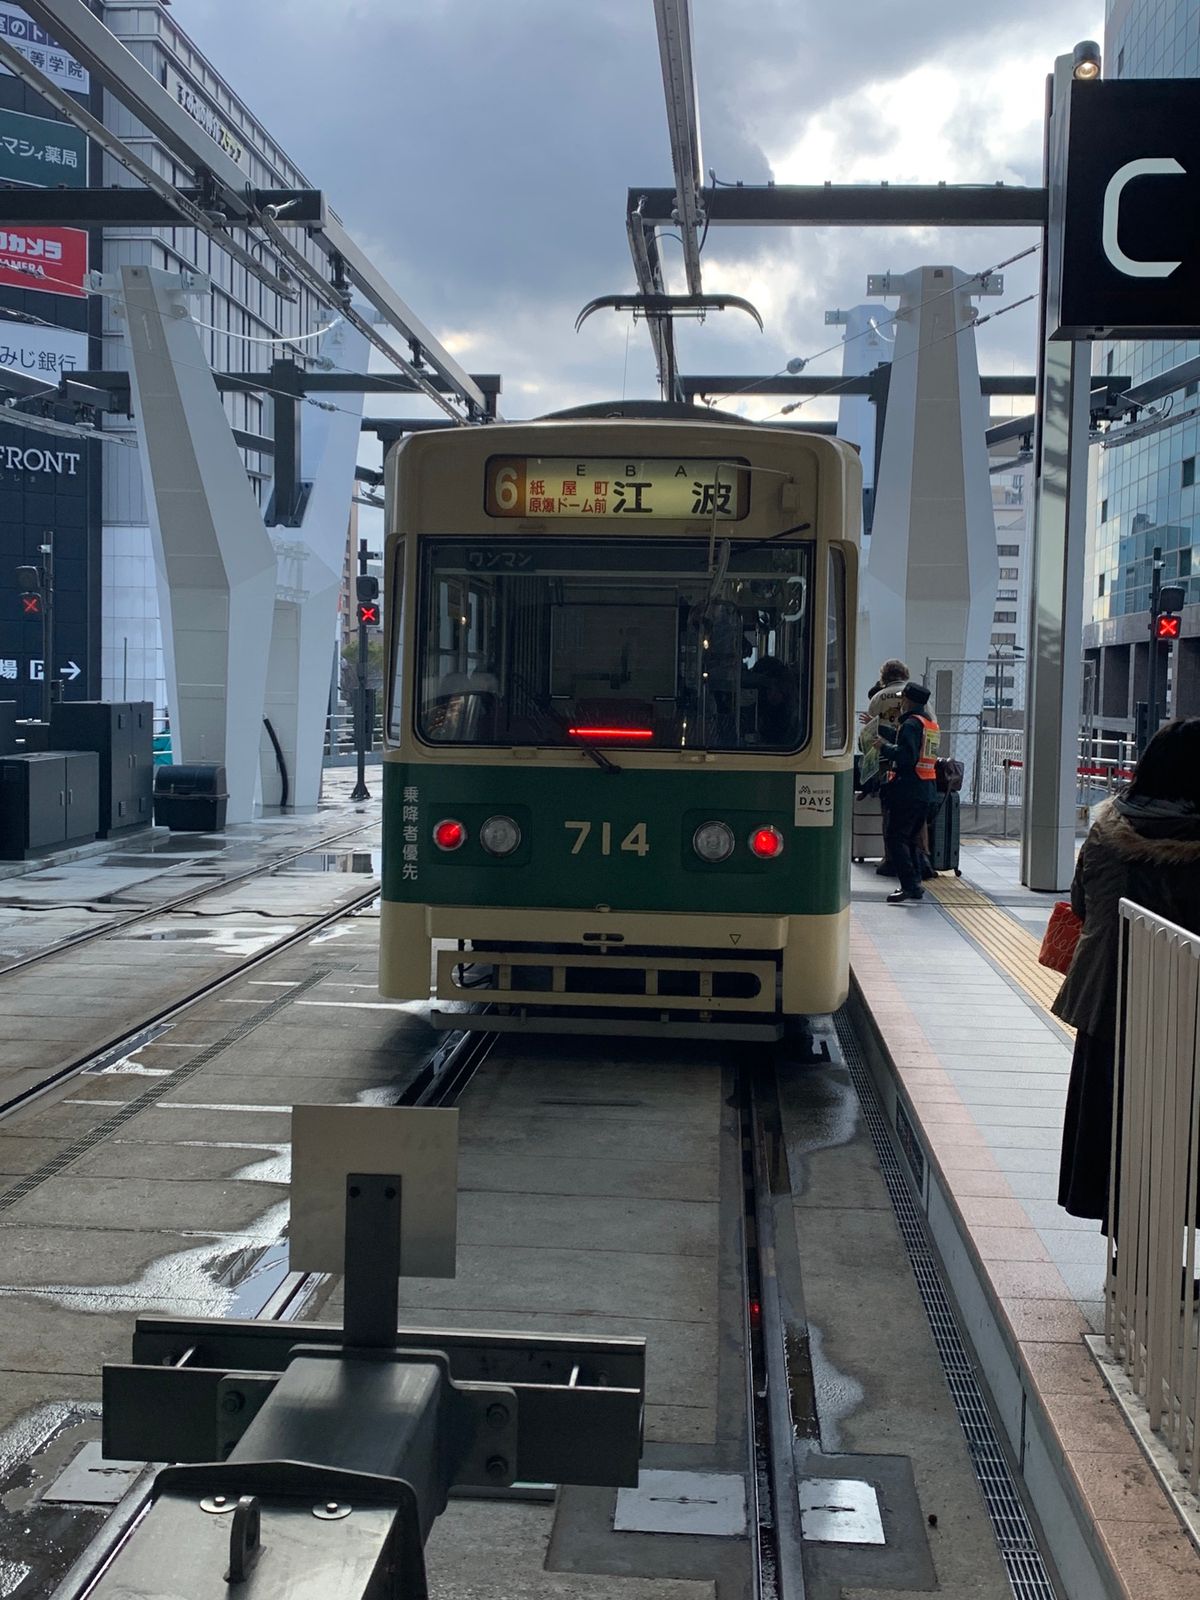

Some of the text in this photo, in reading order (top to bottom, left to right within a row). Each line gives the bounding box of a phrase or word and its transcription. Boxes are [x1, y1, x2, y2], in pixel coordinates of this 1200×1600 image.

[0, 17, 60, 46] のト
[14, 46, 83, 78] 等学院
[0, 136, 77, 168] マシィ薬局
[1102, 158, 1187, 277] C
[0, 259, 45, 274] AMERA
[495, 467, 518, 510] 6
[613, 481, 732, 515] 江波
[528, 497, 607, 514] 原爆ドーム前
[469, 552, 532, 567] ワンマン
[800, 797, 831, 806] DAYS
[403, 786, 419, 880] 乗降者優先
[564, 821, 650, 857] 714
